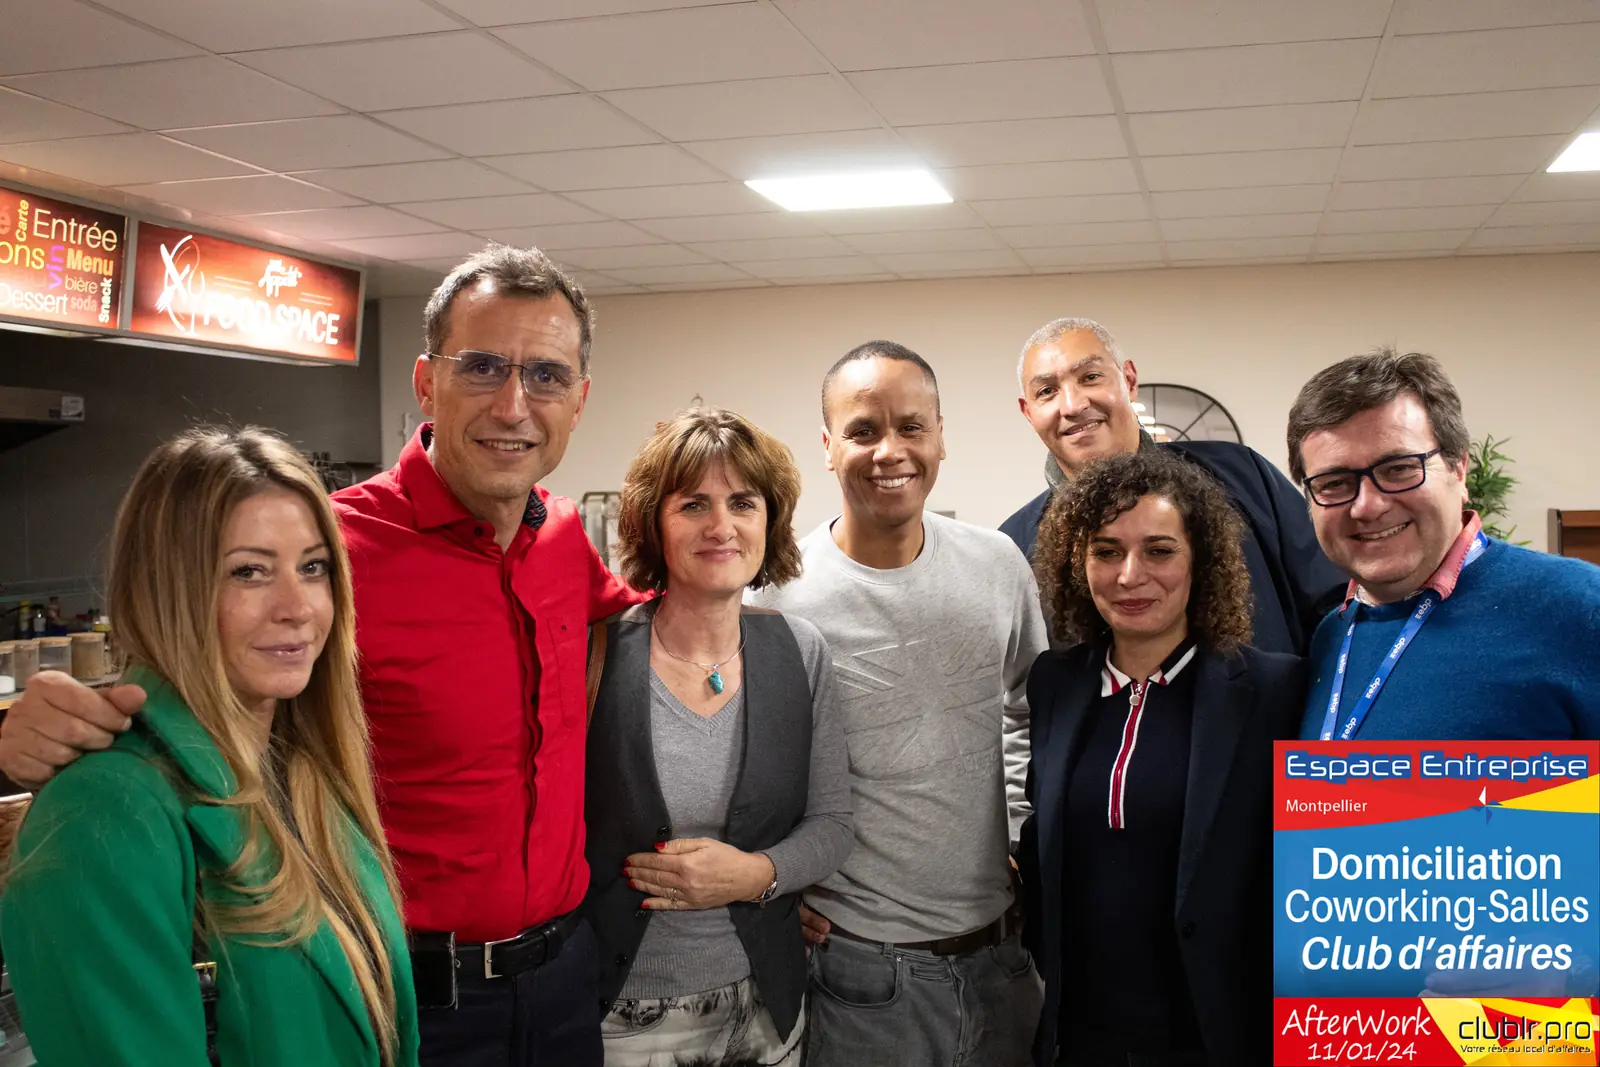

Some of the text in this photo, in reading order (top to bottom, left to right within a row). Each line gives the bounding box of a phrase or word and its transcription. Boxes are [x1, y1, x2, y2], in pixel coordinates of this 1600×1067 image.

[33, 208, 118, 252] Entrée
[46, 245, 65, 290] vin
[65, 275, 98, 294] bière
[66, 248, 114, 277] Menu
[70, 296, 97, 312] soda
[99, 278, 112, 323] Snack
[203, 292, 340, 345] FOOD SPACE
